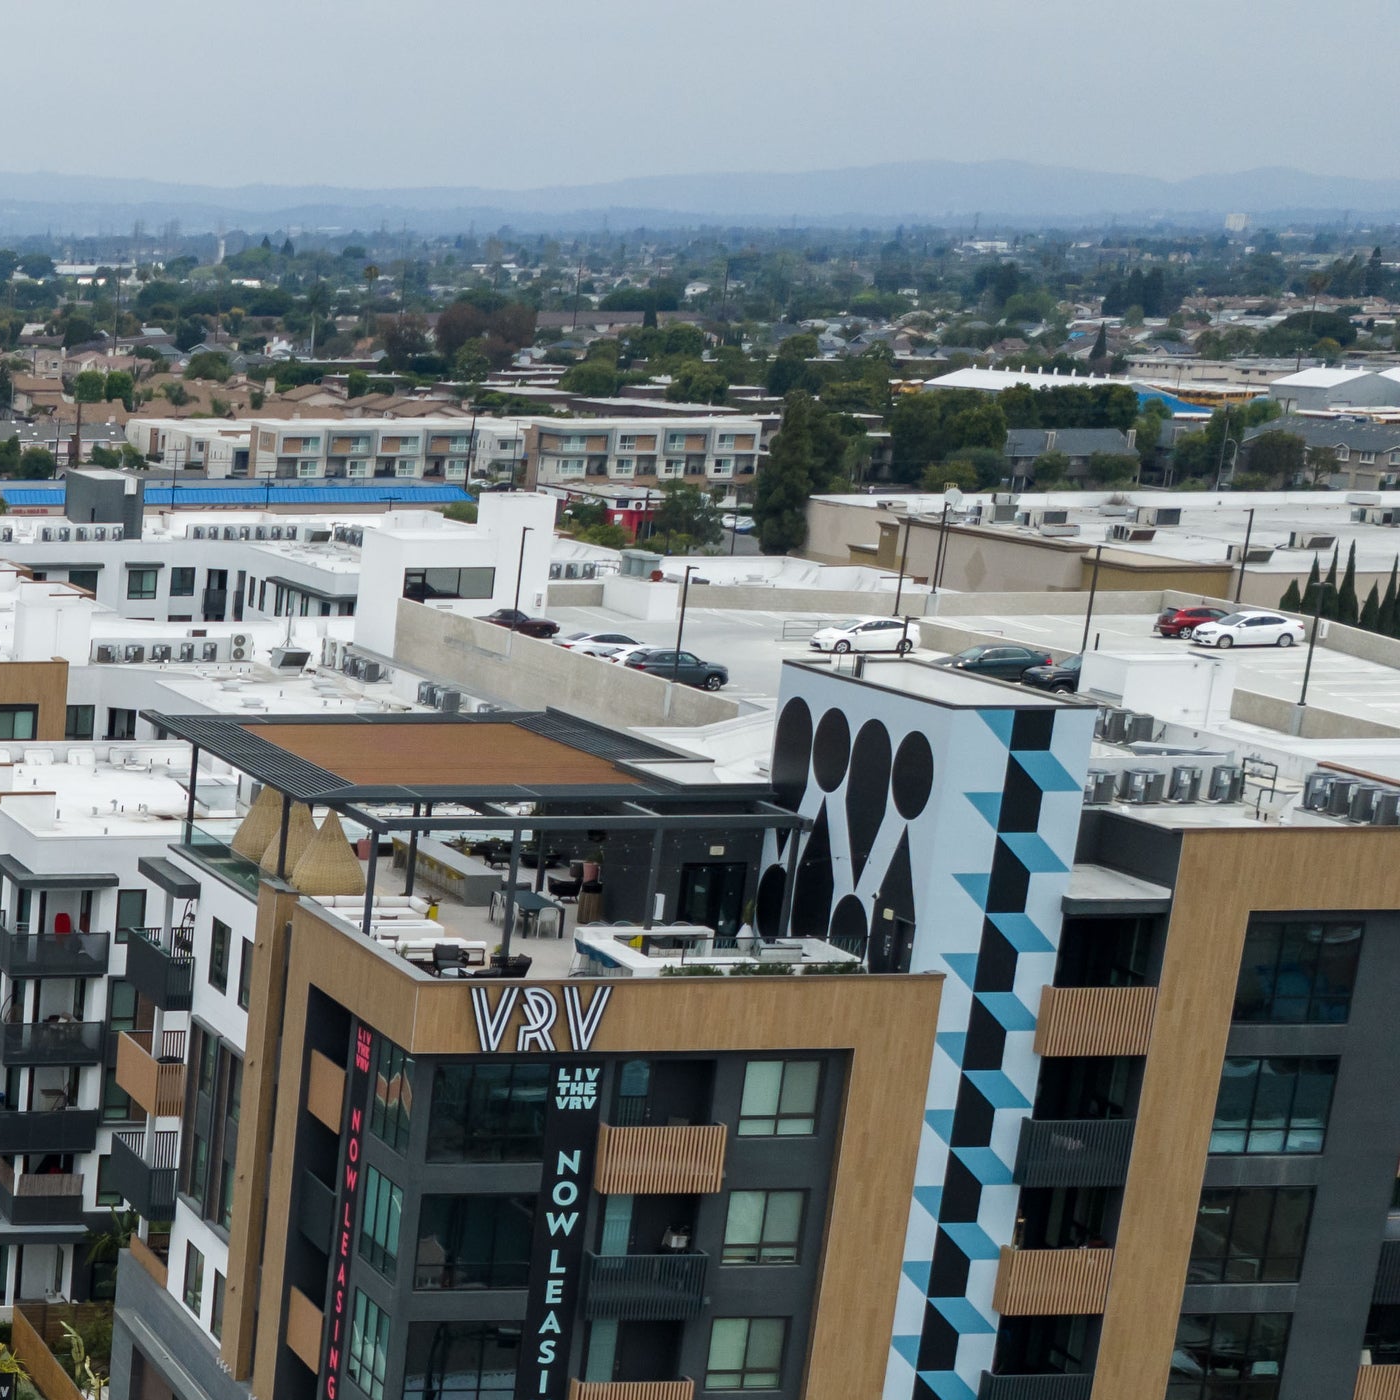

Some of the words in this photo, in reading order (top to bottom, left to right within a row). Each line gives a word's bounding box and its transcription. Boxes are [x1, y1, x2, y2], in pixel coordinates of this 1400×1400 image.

[470, 986, 613, 1052] VRV
[555, 1096, 598, 1110] VRV
[556, 1082, 597, 1095] THE
[558, 1068, 601, 1081] LIV
[345, 1108, 361, 1191] NOW
[547, 1149, 581, 1237] NOW
[327, 1202, 350, 1400] LEASING
